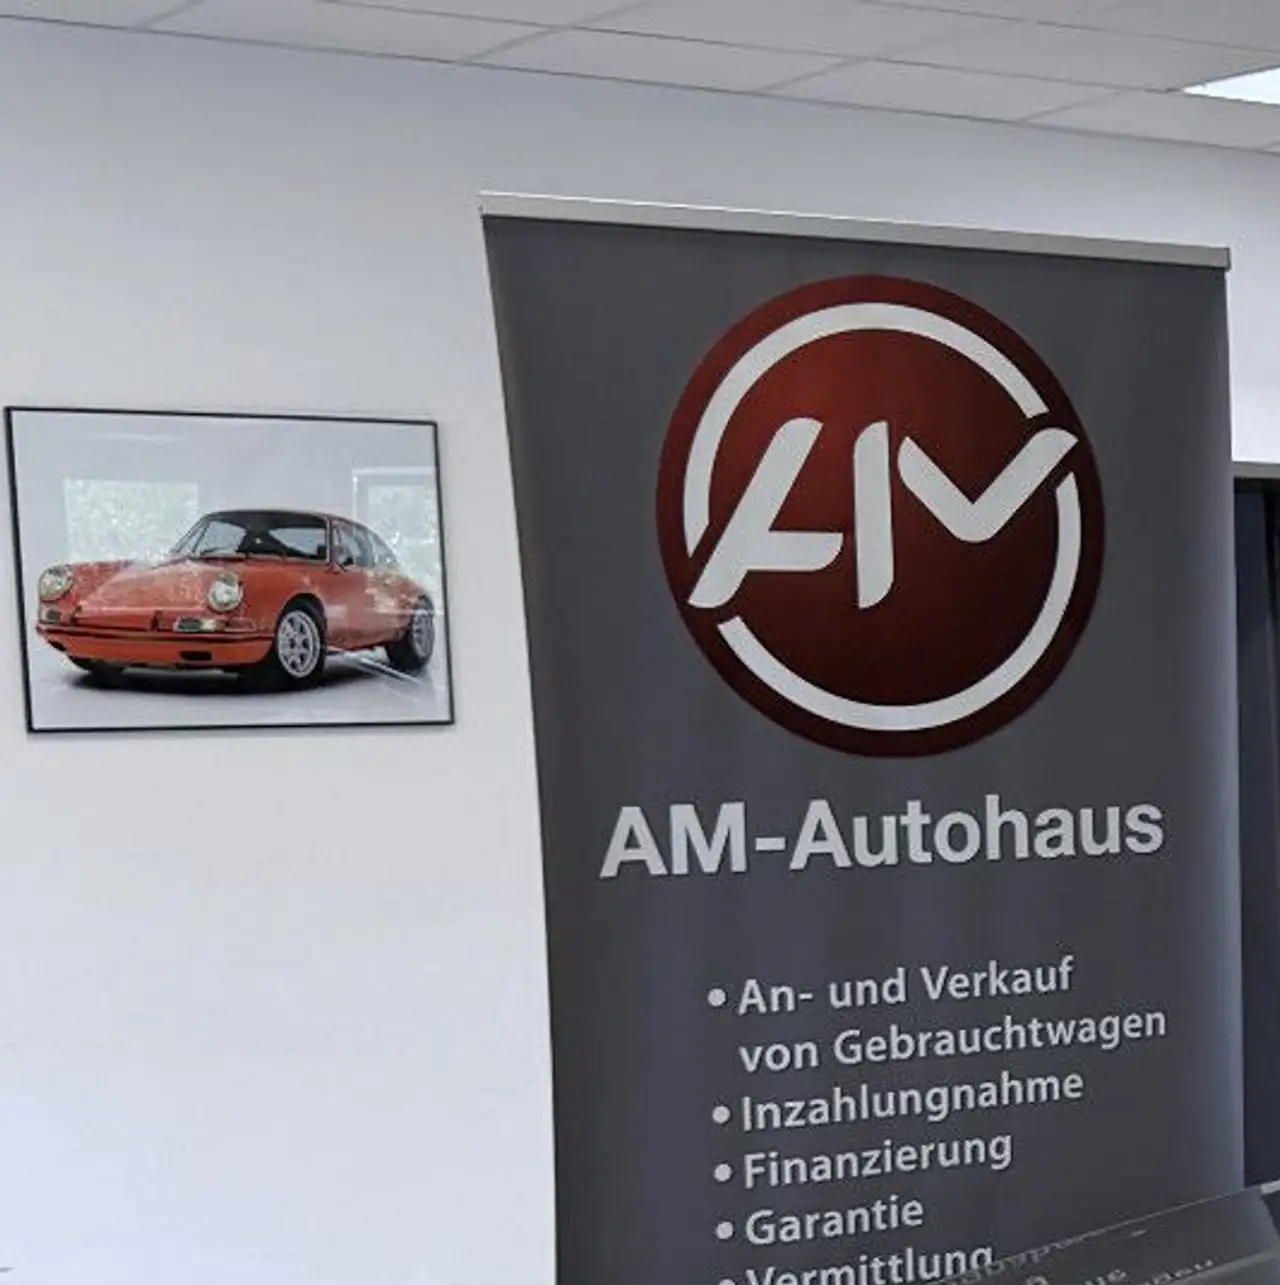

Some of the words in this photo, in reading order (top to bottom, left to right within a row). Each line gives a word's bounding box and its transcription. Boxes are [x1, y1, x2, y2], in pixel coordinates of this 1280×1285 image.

[599, 794, 1163, 878] AM-Autohaus
[739, 978, 814, 1015] An-
[829, 965, 906, 1009] und
[920, 955, 1074, 1000] Verkauf
[739, 1042, 820, 1072] von
[833, 1008, 1167, 1067] Gebrauchtwagen
[743, 1073, 1083, 1131] Inzahlungnahme
[744, 1134, 1013, 1189] Finanzierung
[745, 1194, 924, 1245] Garantie
